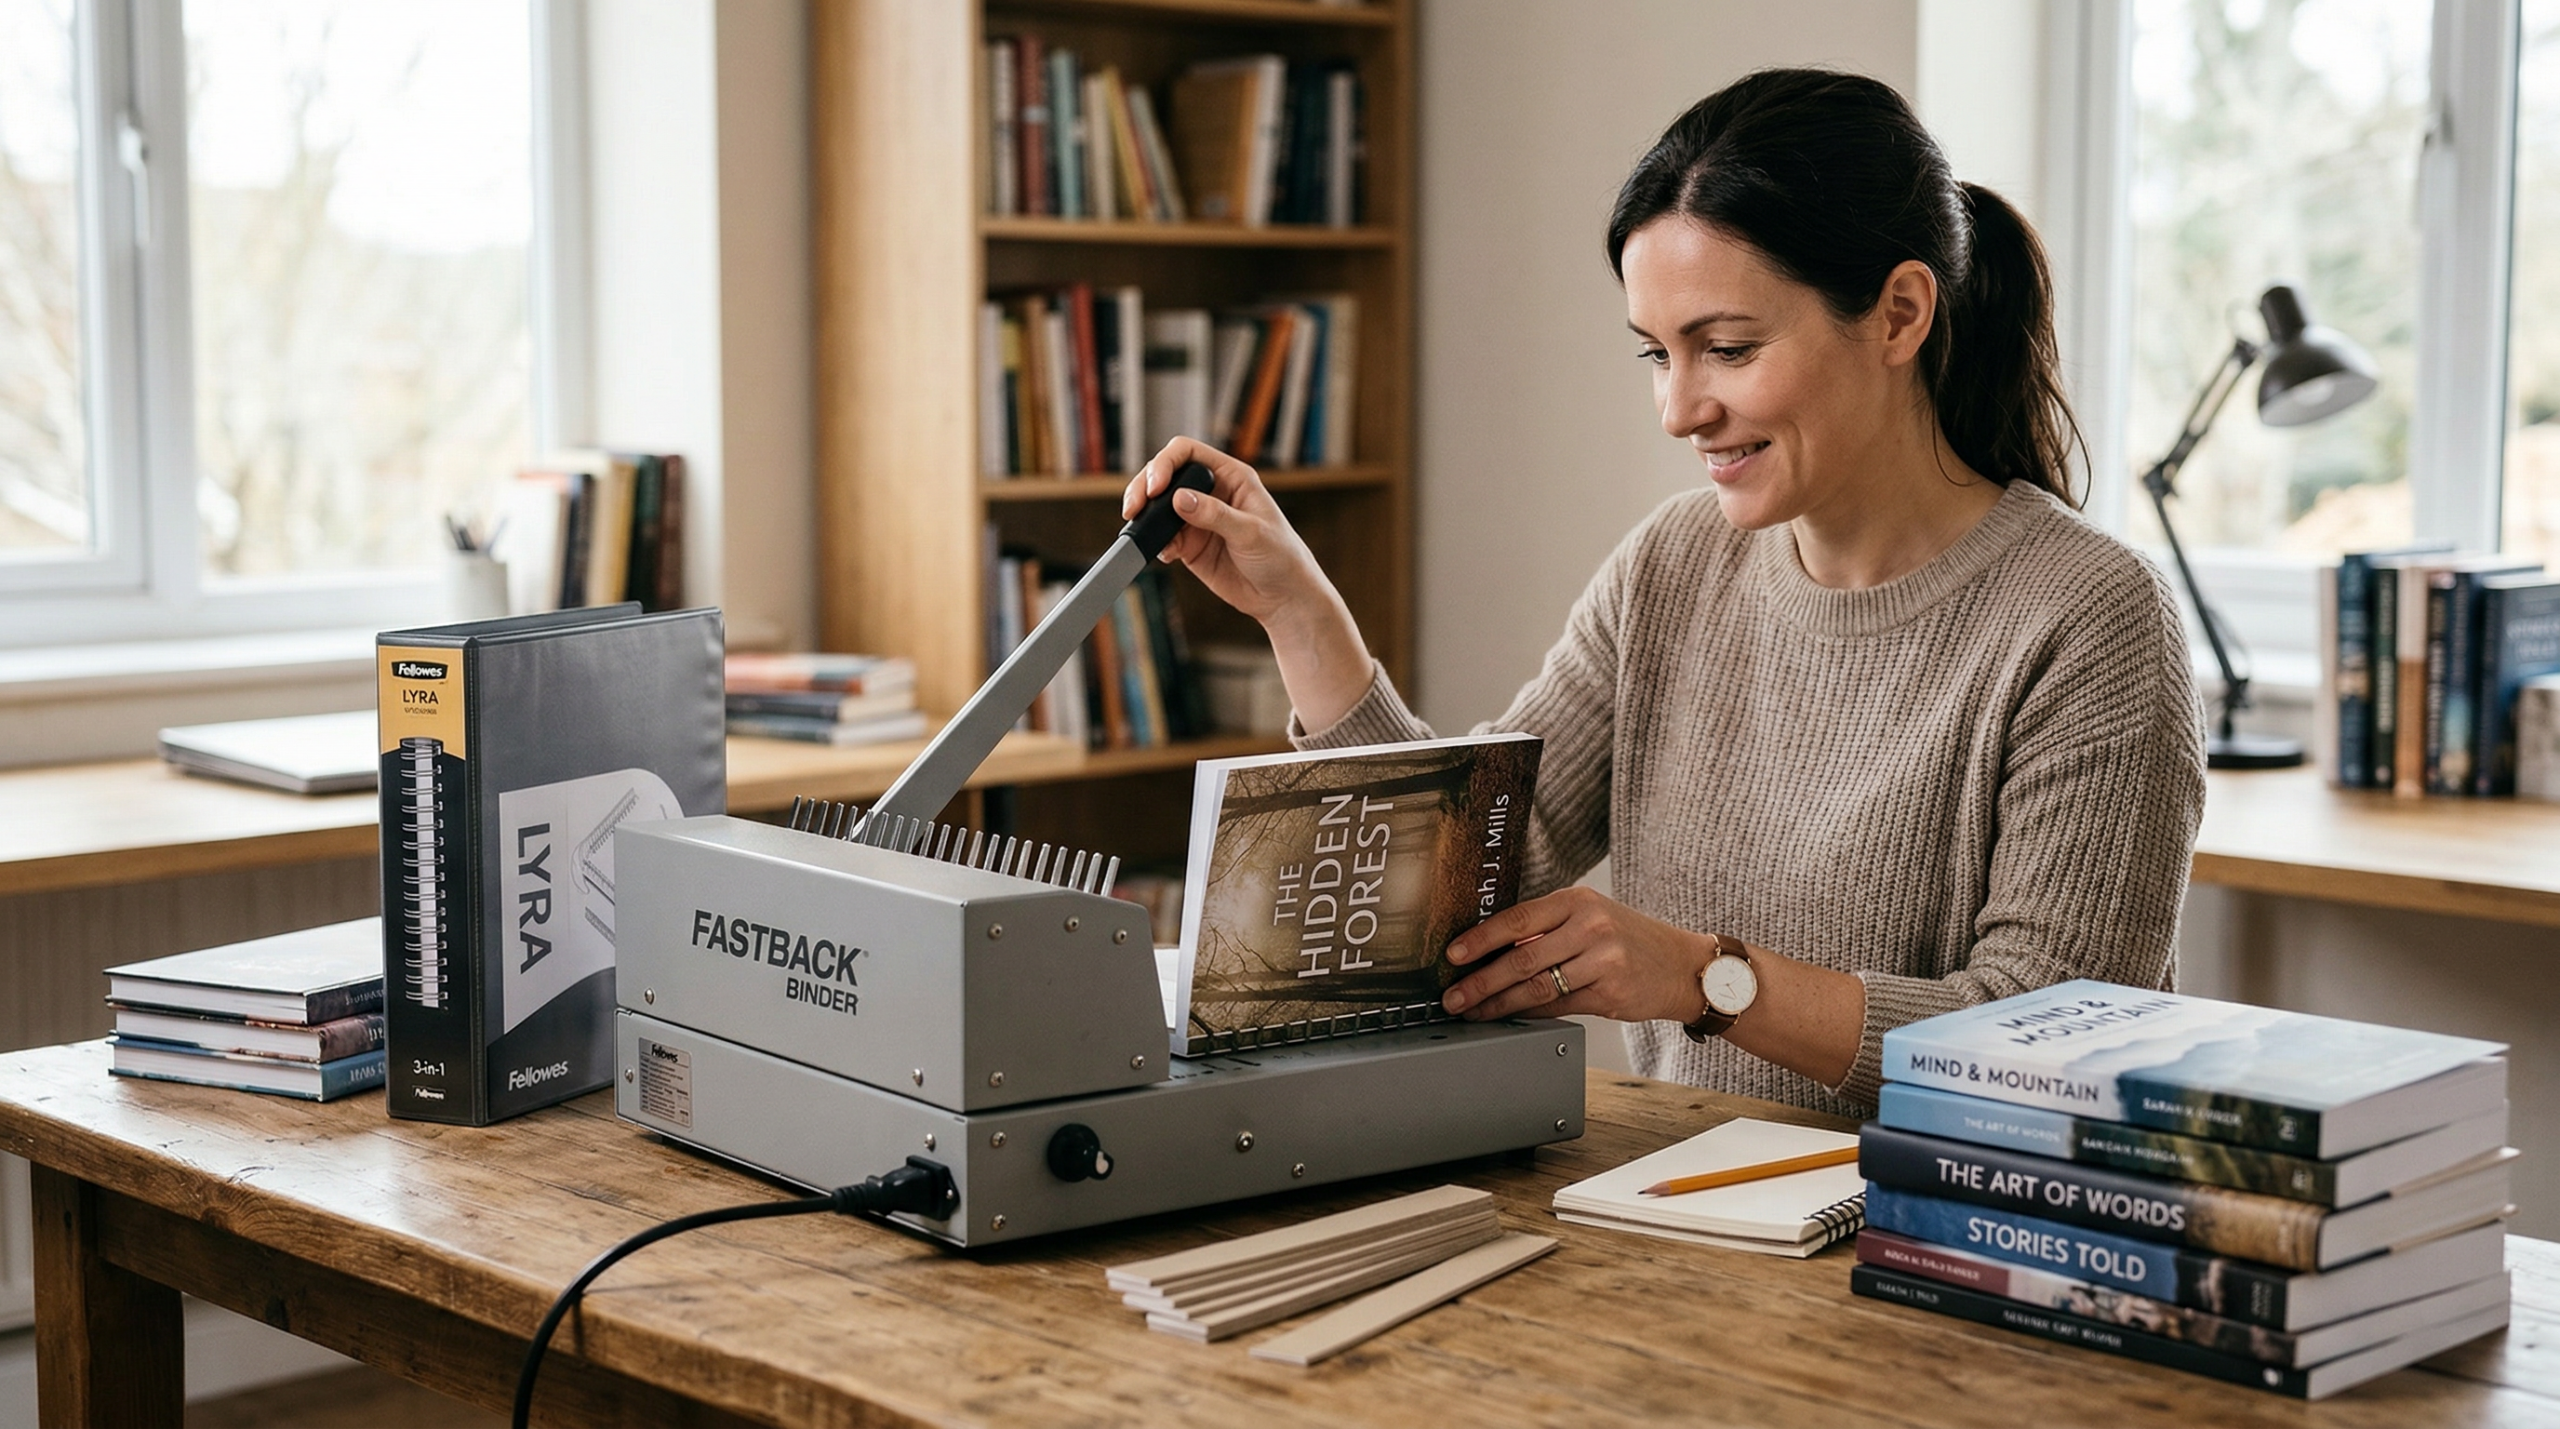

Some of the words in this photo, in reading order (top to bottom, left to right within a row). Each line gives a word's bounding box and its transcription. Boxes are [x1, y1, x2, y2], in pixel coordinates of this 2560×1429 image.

[398, 663, 442, 677] Fellowes
[402, 689, 439, 704] LYRA
[1485, 793, 1510, 848] Mills
[1297, 793, 1354, 979] HIDDEN
[1340, 795, 1394, 971] FOREST
[1482, 855, 1500, 871] J.
[518, 823, 553, 974] LYRA
[1273, 862, 1302, 926] THE
[1477, 877, 1497, 926] rah
[691, 909, 862, 986] FASTBACK
[786, 977, 859, 1016] BINDER
[1996, 1006, 2084, 1030] MIND
[2078, 999, 2114, 1010] &
[2008, 998, 2185, 1045] MOUNTAIN
[413, 1059, 445, 1076] 3-in-1
[508, 1061, 569, 1091] Fellowes
[1910, 1053, 1962, 1078] MIND
[1968, 1063, 1981, 1082] &
[1987, 1068, 2099, 1102] MOUNTAIN
[1937, 1157, 1983, 1190] THE
[1989, 1170, 2040, 1200] ART
[2044, 1180, 2080, 1207] OF
[2087, 1188, 2186, 1231] WORDS
[1967, 1217, 2068, 1264] STORIES
[2075, 1243, 2146, 1282] TOLD
